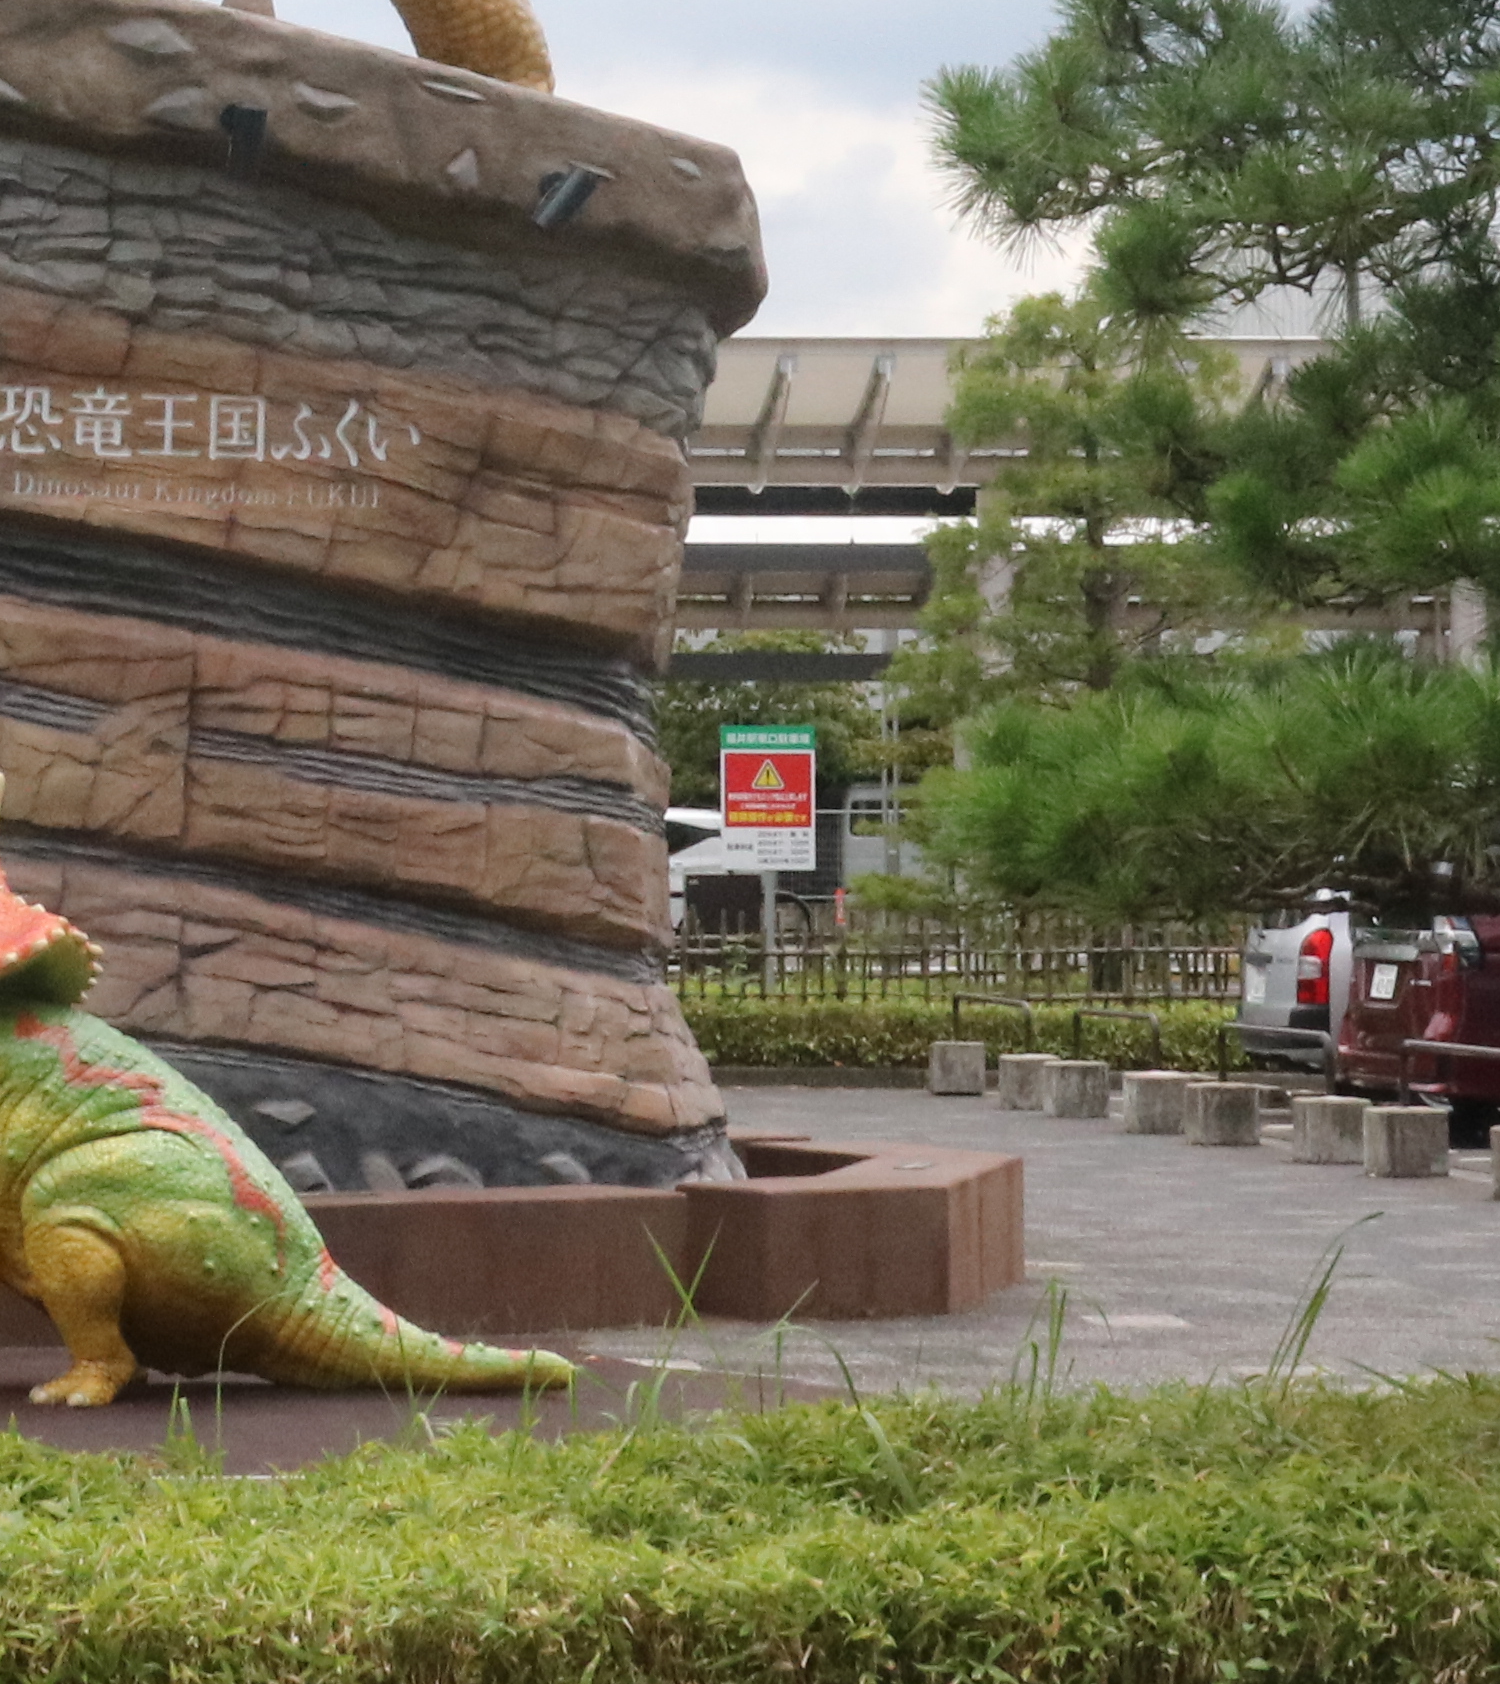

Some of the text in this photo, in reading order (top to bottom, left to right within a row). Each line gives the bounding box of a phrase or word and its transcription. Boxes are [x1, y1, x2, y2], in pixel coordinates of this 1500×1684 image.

[12, 469, 383, 510] Dinosaur Kingdom FUKUI
